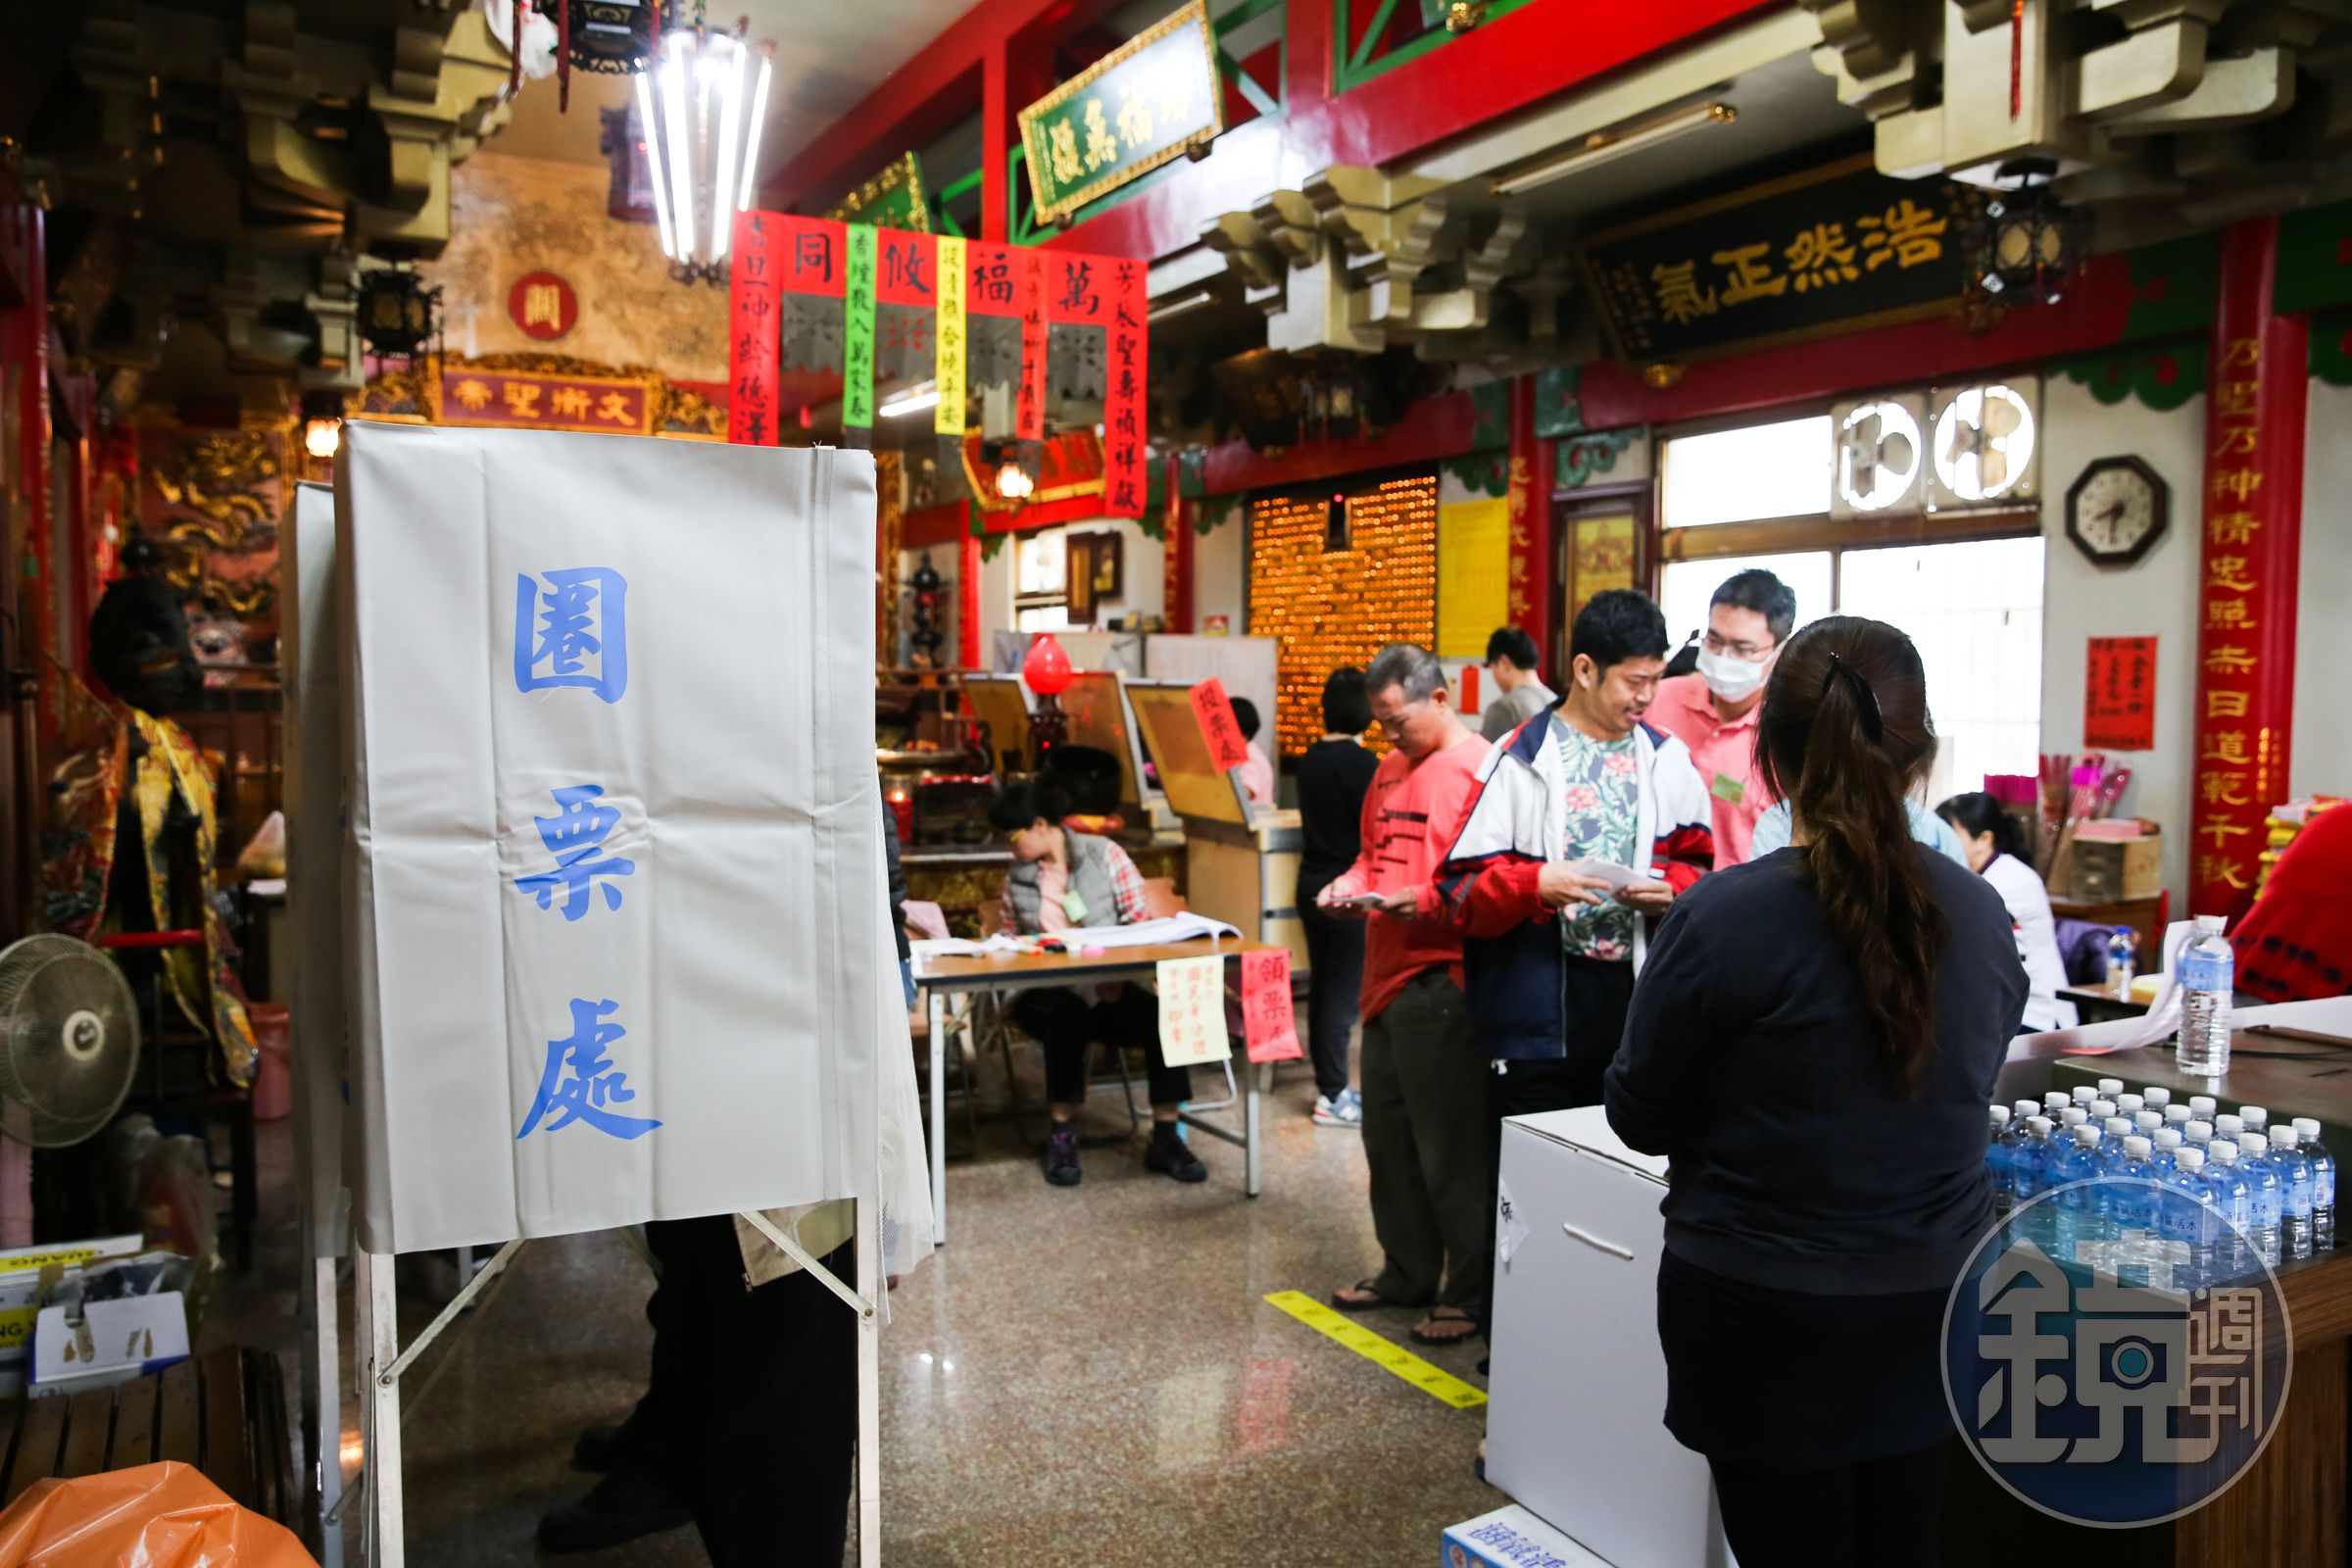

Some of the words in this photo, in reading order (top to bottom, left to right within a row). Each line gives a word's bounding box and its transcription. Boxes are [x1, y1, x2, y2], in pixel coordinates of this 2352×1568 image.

[795, 231, 1100, 316] 萬福攸同
[1650, 199, 1948, 325] 浩然正氣
[514, 566, 663, 1140] 圈票處
